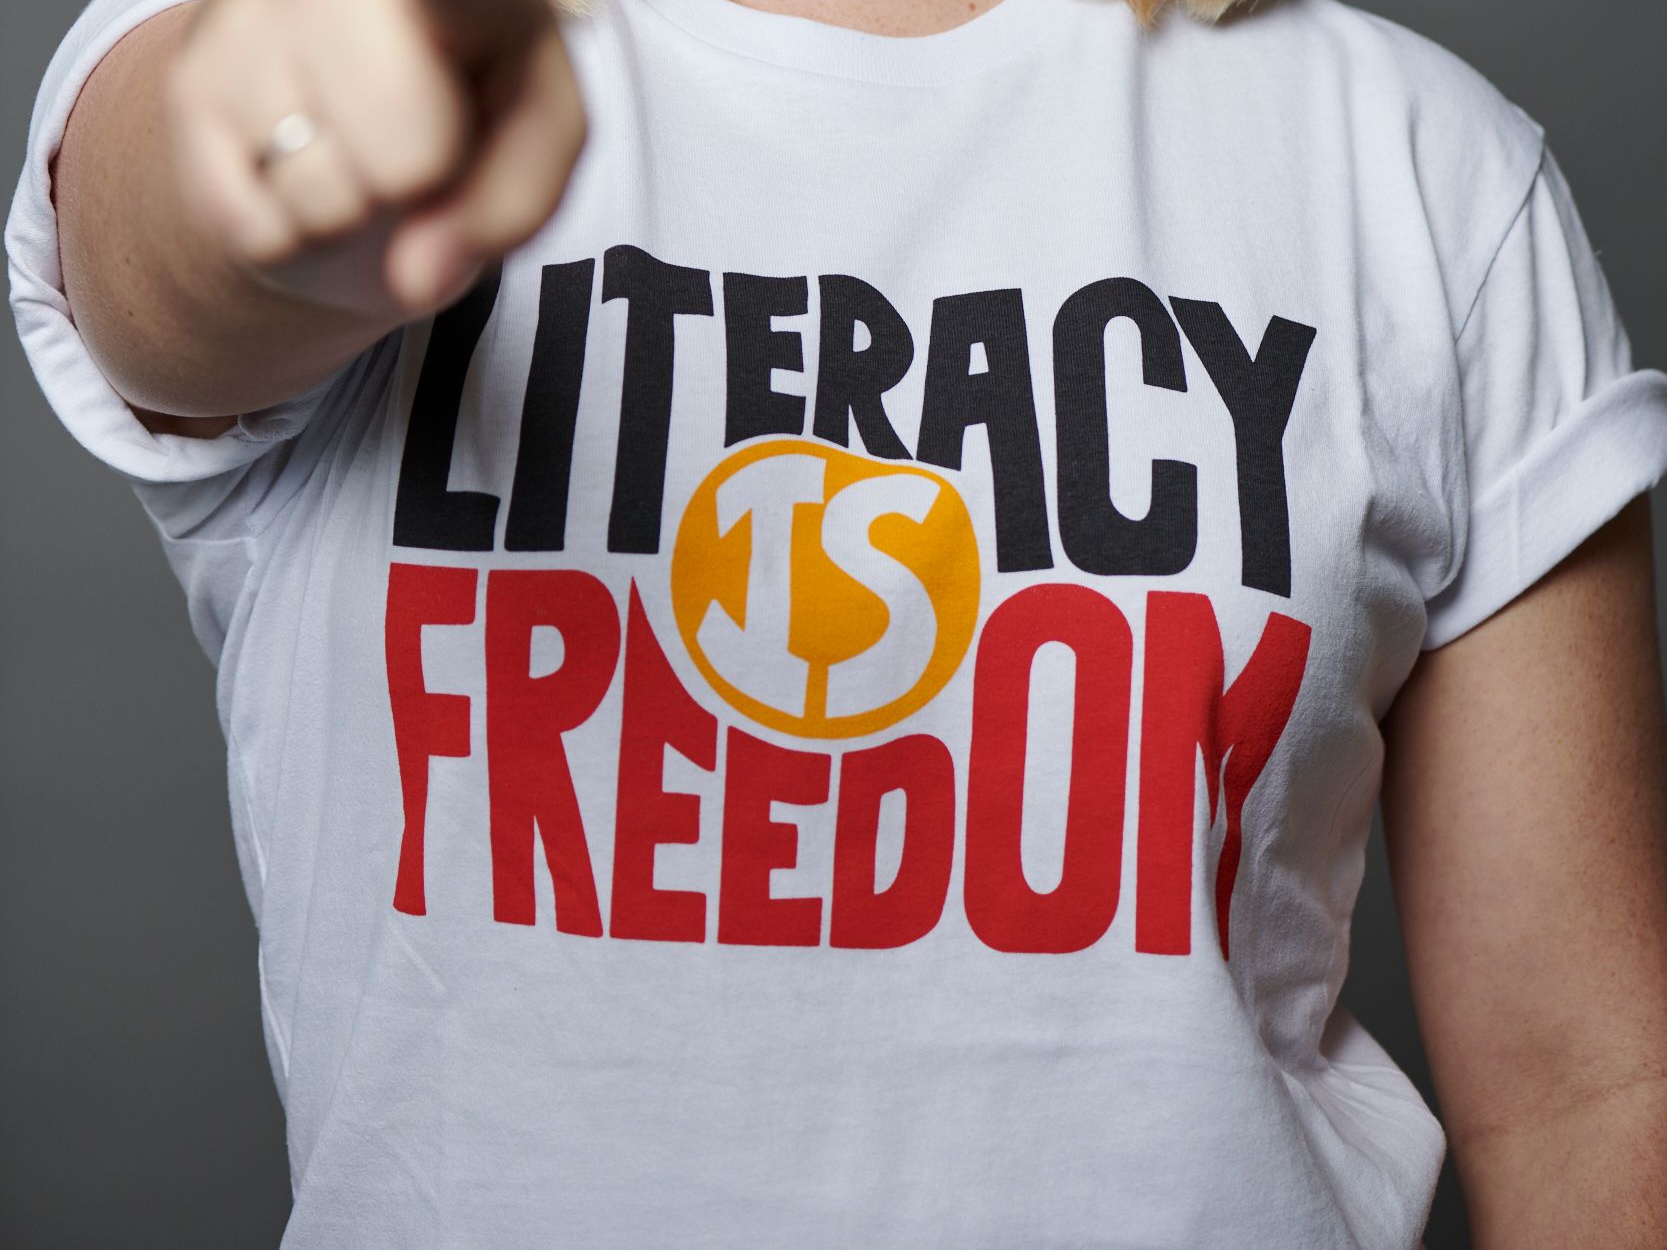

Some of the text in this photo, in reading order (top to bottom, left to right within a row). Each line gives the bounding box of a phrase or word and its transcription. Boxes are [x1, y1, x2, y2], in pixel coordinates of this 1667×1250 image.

[392, 244, 1317, 598] LITERACY
[695, 453, 942, 720] IS
[384, 562, 1312, 961] FREEDOM
